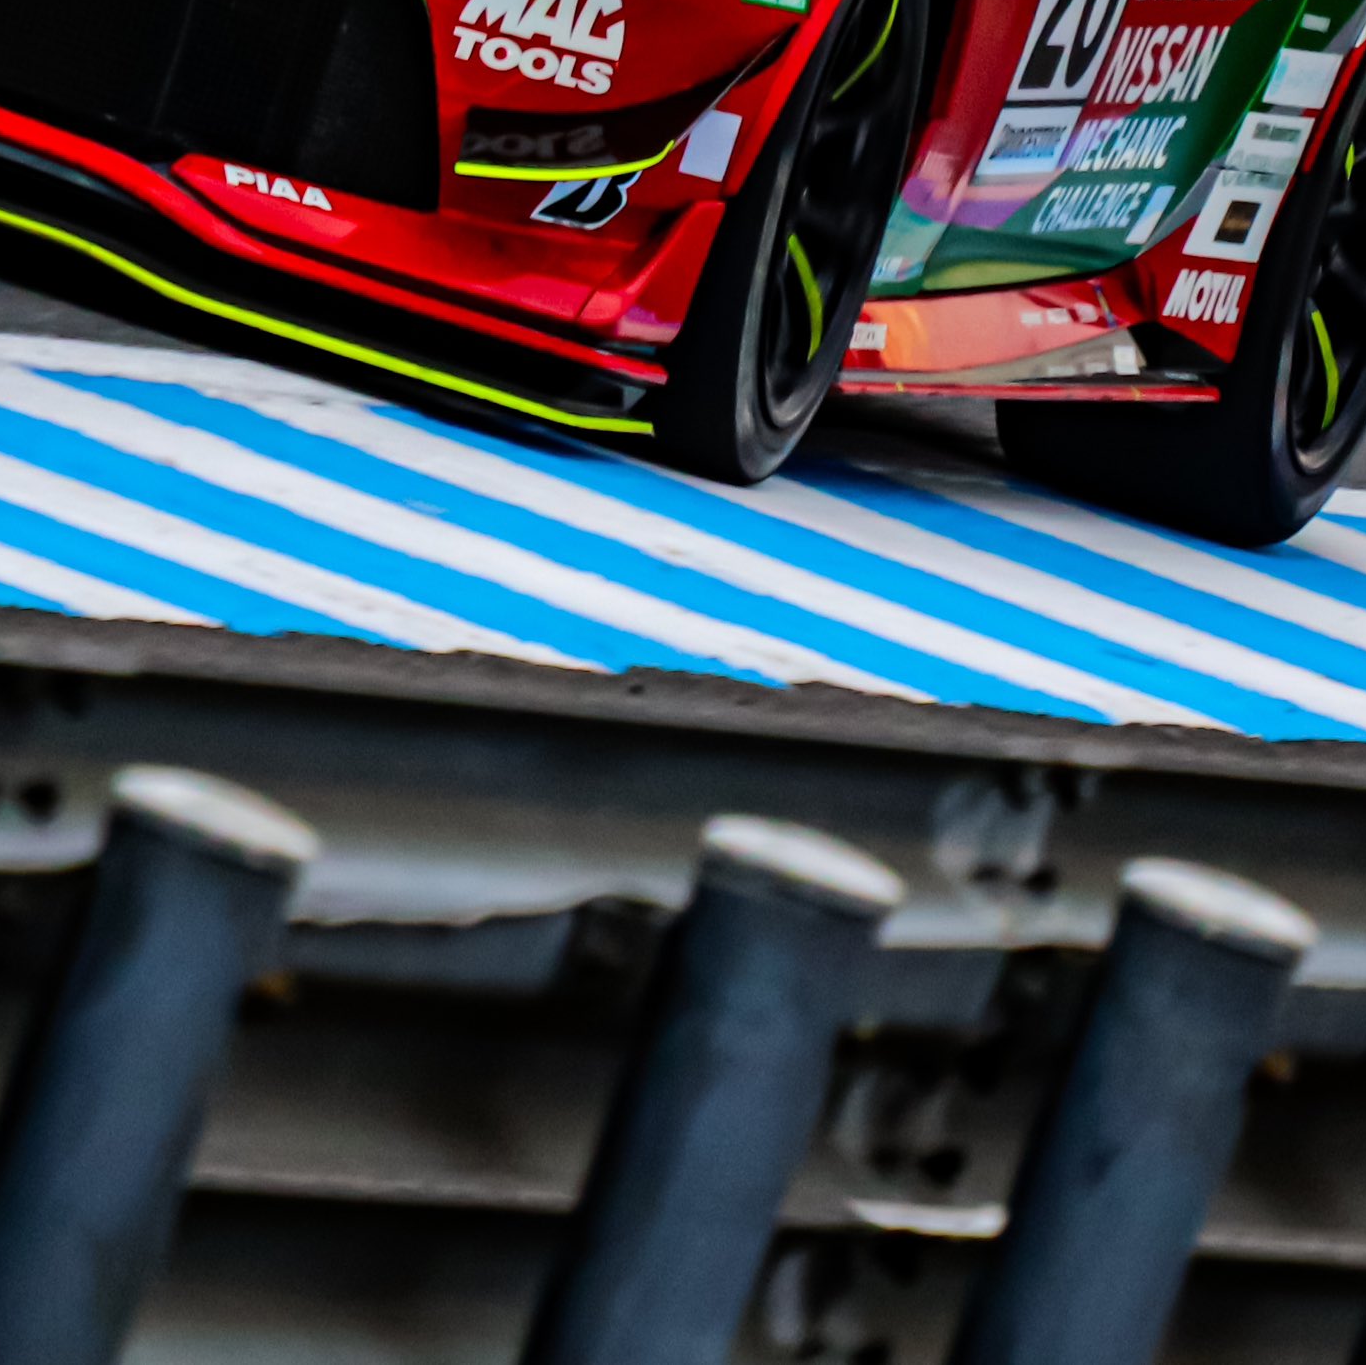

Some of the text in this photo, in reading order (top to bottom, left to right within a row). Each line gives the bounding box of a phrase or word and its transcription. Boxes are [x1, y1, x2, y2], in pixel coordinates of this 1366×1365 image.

[453, 26, 615, 96] TOOLS
[1094, 25, 1232, 104] NISSAN
[1065, 116, 1187, 172] MECHANIC
[224, 163, 332, 211] PIAA
[1031, 182, 1152, 235] CHALLENGE
[1162, 268, 1246, 325] MOTUL
